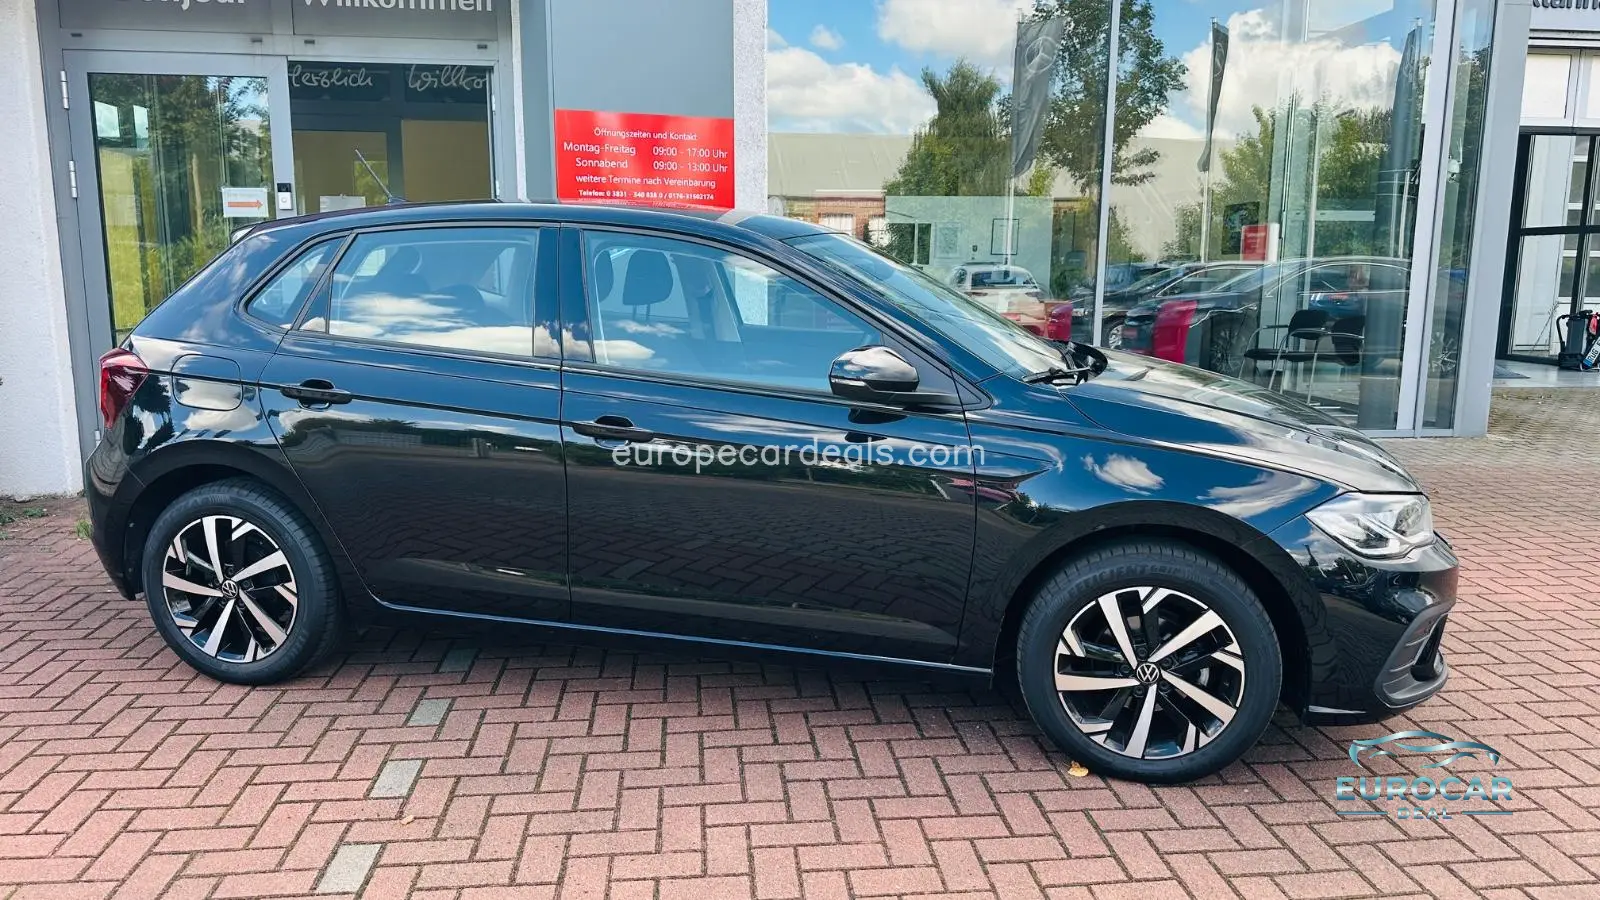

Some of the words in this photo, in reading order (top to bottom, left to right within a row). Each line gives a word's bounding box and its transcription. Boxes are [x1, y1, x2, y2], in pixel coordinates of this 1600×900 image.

[594, 127, 651, 139] Öffnungszeiten
[653, 131, 668, 139] und
[669, 132, 698, 141] Kontakt
[563, 141, 637, 156] Montag-Freitag
[653, 147, 678, 157] 09:00
[687, 148, 710, 158] 17:00
[712, 149, 728, 159] Uhr
[575, 157, 629, 169] Sonnabend
[653, 160, 678, 171] 09:00
[687, 162, 710, 172] 13:00
[712, 163, 728, 173] Uhr
[575, 174, 607, 184] weitere
[608, 175, 641, 185] Termine
[643, 176, 662, 186] nach
[664, 177, 716, 189] Vereinbarung
